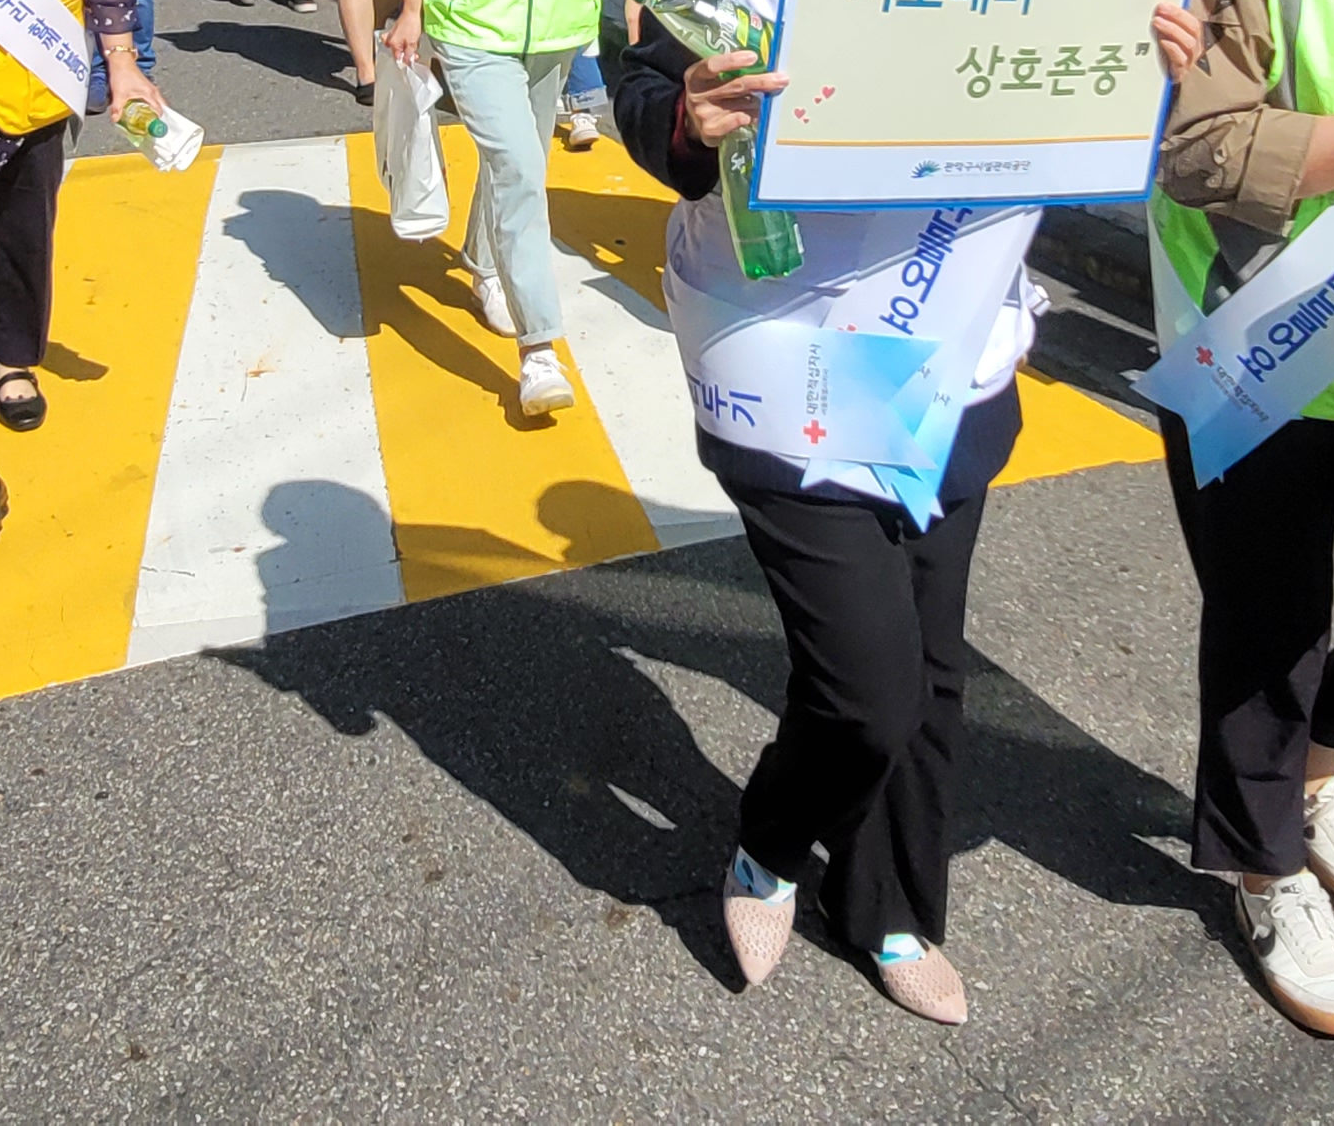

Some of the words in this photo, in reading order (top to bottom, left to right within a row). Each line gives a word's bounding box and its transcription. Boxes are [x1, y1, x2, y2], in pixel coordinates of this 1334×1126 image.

[27, 17, 62, 51] 함께
[56, 44, 90, 84] 만들어
[943, 159, 1032, 173] 관악구시설관리공단
[878, 207, 974, 336] 들어요
[805, 343, 823, 416] 대한적십자사
